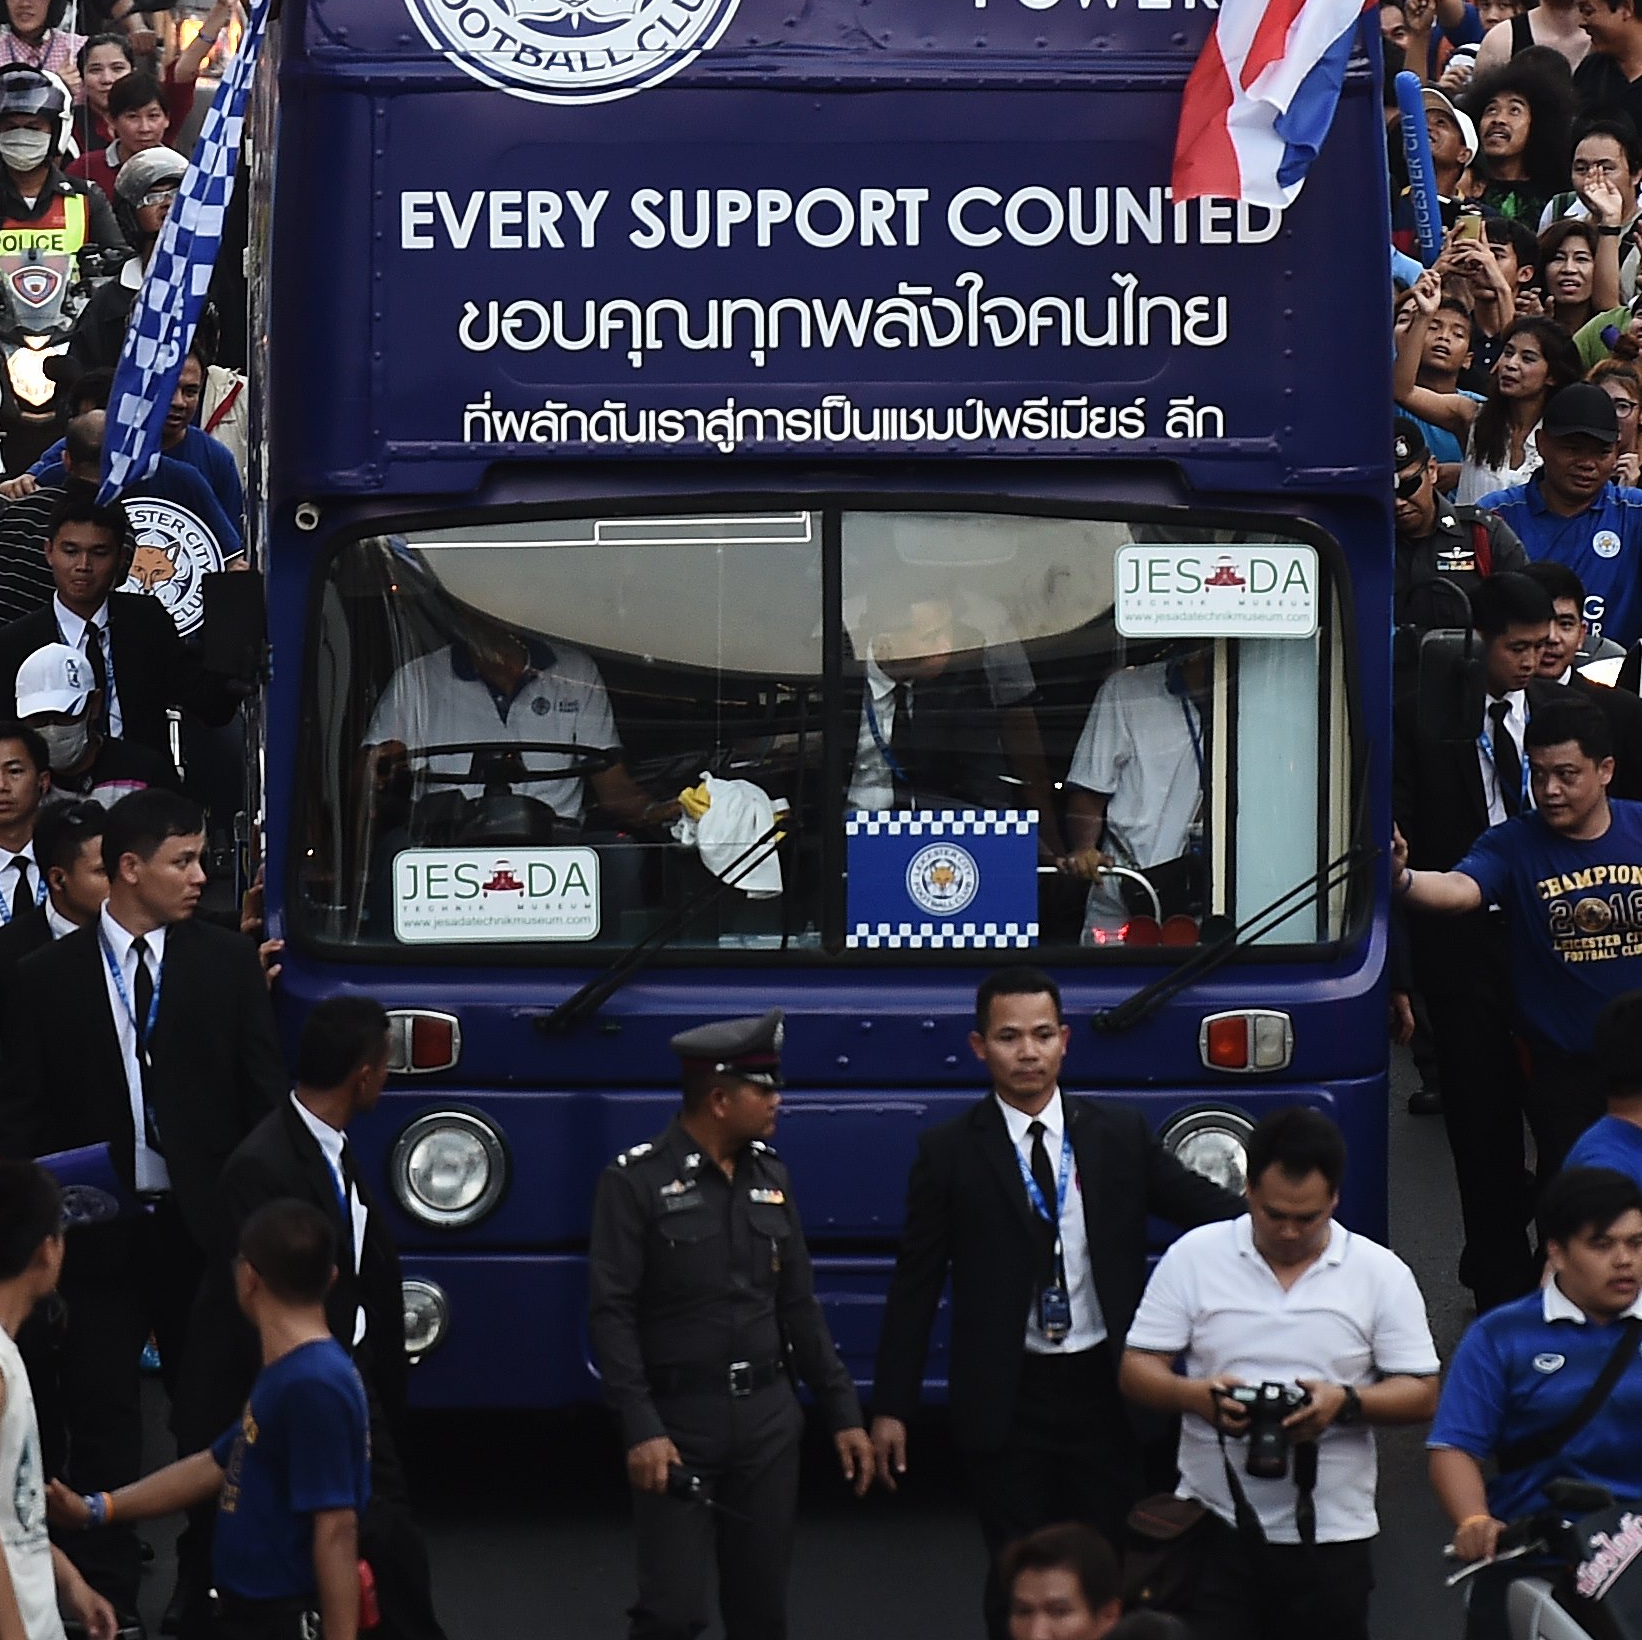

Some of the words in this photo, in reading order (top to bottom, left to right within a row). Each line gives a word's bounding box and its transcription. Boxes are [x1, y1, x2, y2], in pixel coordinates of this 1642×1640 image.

[1401, 112, 1419, 153] CITY
[400, 190, 610, 250] EVERY
[628, 186, 929, 250] SUPPORT
[947, 185, 1284, 246] COUNTED
[1407, 157, 1434, 249] LEICESTER
[458, 271, 1229, 368] ขอบคุณทุกพลังใจคนไทย
[462, 391, 1146, 453] ที่ผลักดันเราสู่การเป็นแชมป์พรีเมียร์
[1164, 394, 1224, 439] ลีก
[185, 531, 212, 573] CITY
[173, 586, 204, 624] CLU
[914, 848, 957, 878] LEICESTER
[403, 914, 592, 930] www.jesadatechnikmuseum.com
[1553, 933, 1622, 951] LEICESTER
[1564, 947, 1619, 963] FOOTBALL
